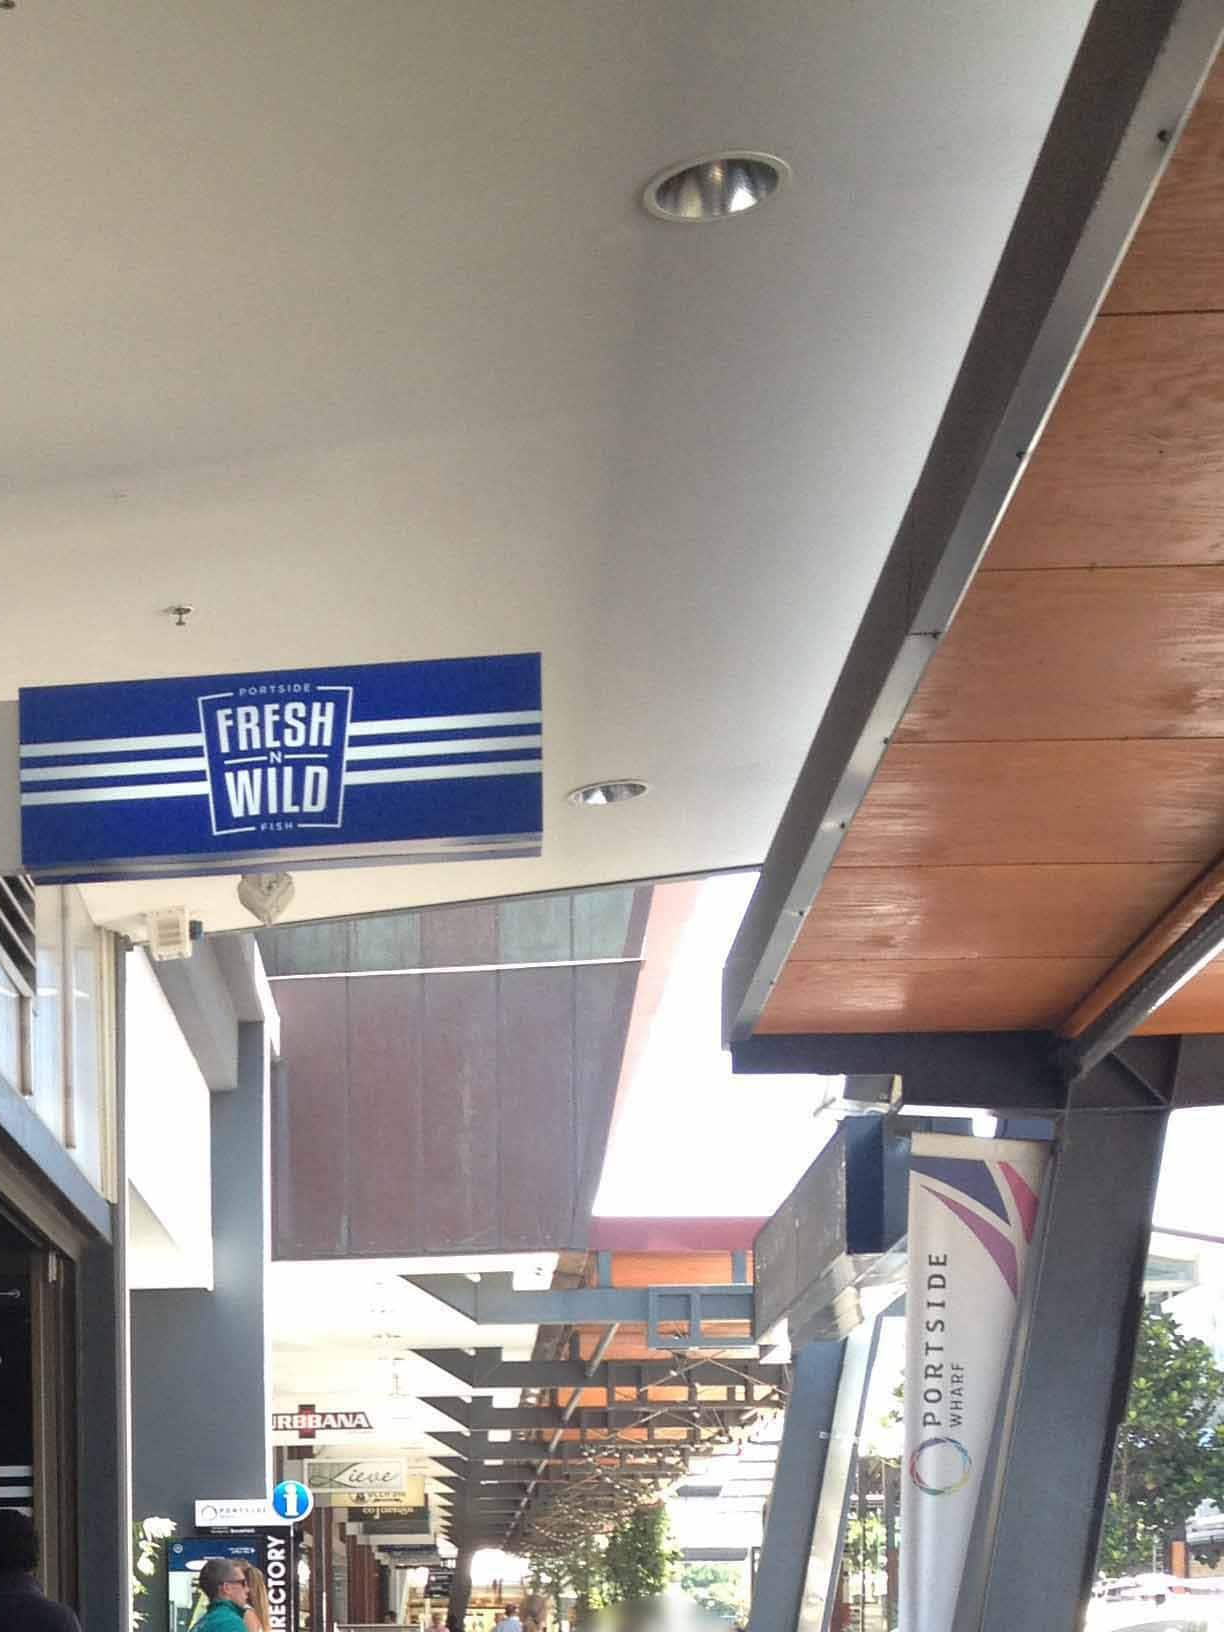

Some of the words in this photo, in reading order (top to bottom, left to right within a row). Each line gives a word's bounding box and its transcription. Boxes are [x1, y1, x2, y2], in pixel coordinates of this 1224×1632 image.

[238, 683, 311, 697] PORTSIDE
[215, 701, 336, 753] FRESH
[269, 751, 283, 764] N
[224, 765, 329, 818] WILD
[260, 821, 294, 832] FISH
[922, 1253, 948, 1428] PORTSIDE
[949, 1362, 965, 1428] WHARF
